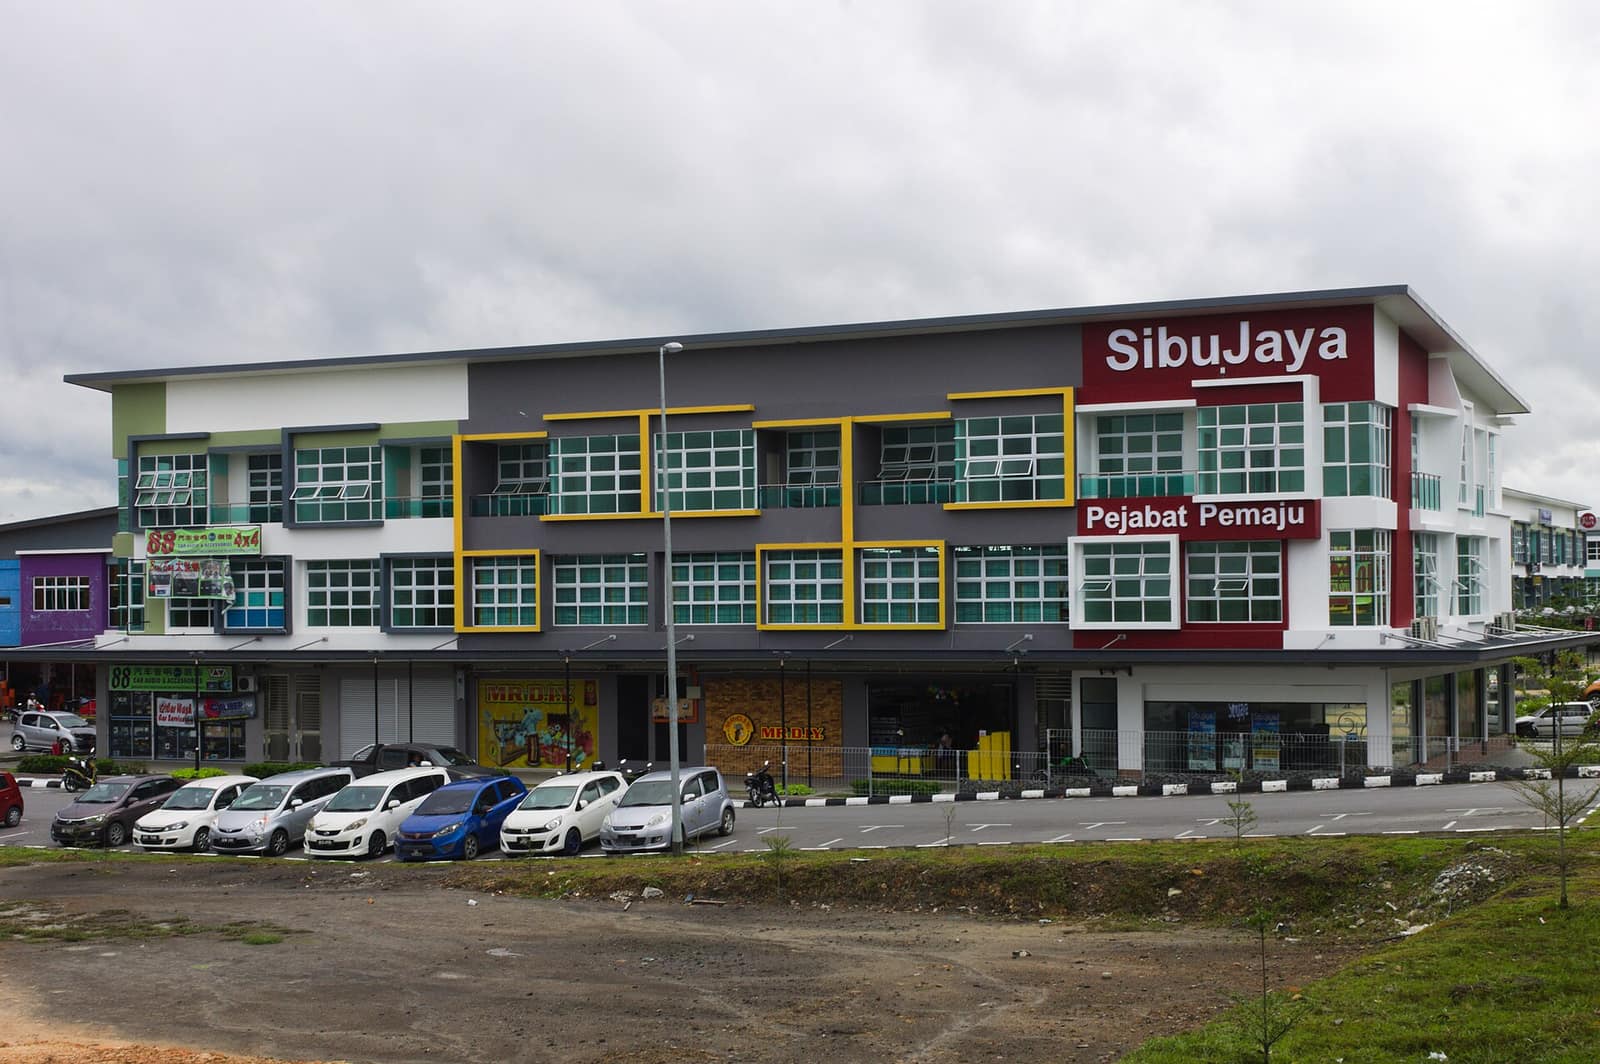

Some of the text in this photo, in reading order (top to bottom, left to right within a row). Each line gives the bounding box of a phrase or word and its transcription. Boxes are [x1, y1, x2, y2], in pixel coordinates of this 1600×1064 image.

[1086, 502, 1304, 535] Pejabat Pemaju
[147, 530, 176, 554] 88
[111, 667, 130, 688] 88
